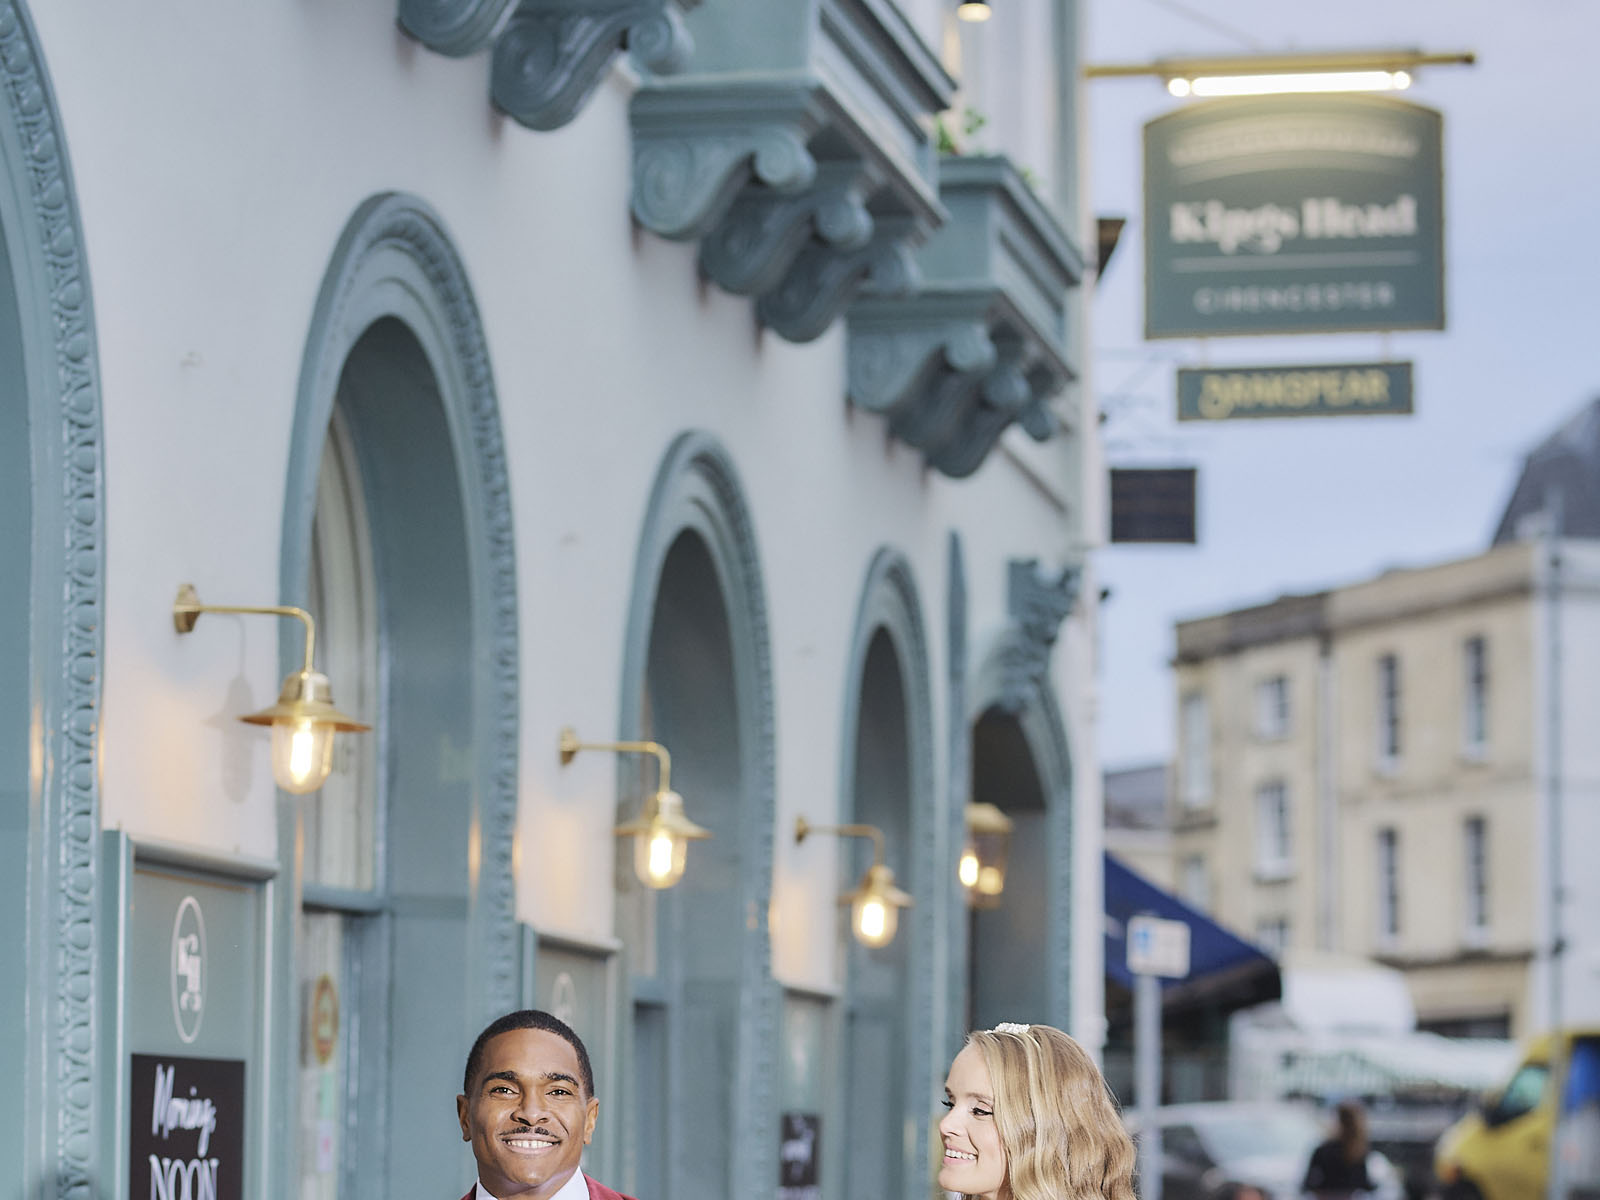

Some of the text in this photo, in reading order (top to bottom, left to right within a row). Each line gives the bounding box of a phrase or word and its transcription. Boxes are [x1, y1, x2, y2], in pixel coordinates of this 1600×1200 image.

[1170, 195, 1418, 255] Kings Head
[1194, 282, 1396, 314] CIRENCESTER
